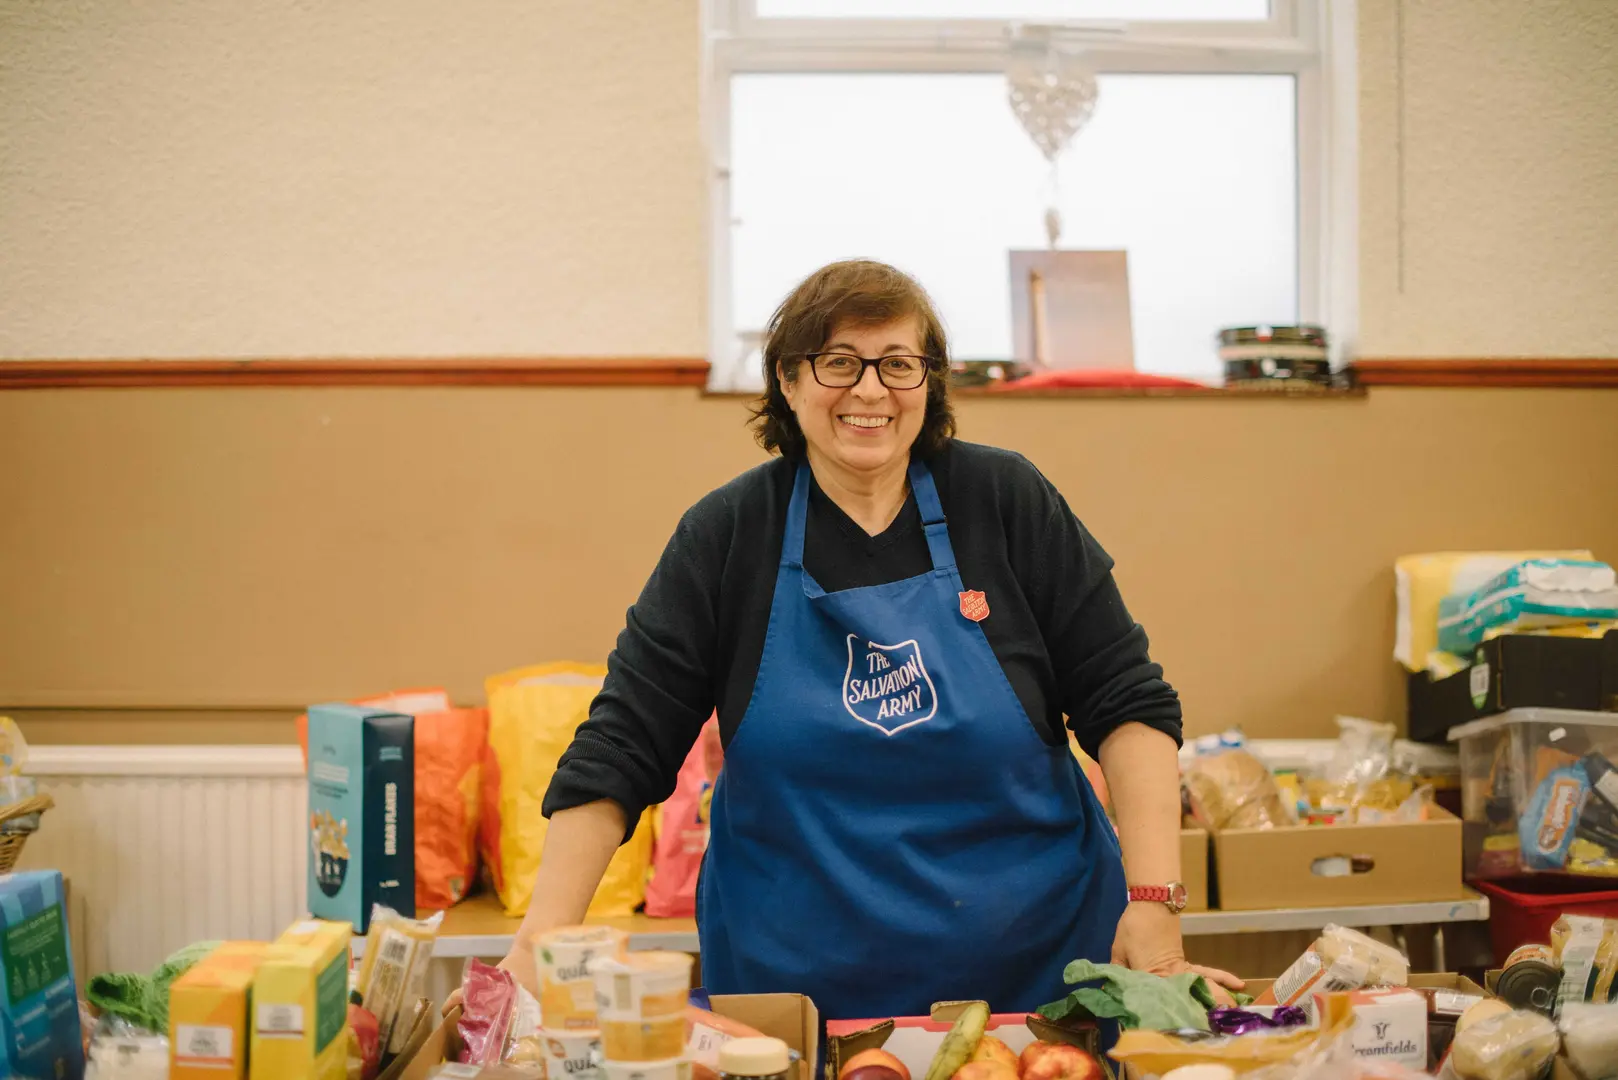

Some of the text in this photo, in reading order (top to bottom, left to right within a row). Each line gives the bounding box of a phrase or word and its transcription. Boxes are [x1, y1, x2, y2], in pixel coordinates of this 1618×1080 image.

[963, 593, 976, 605] THE
[972, 603, 986, 618] ARMY
[866, 652, 890, 674] THE
[849, 655, 921, 704] SALVATION
[877, 685, 921, 720] ARMY
[557, 965, 591, 981] QUA
[1352, 1040, 1417, 1056] reamfields
